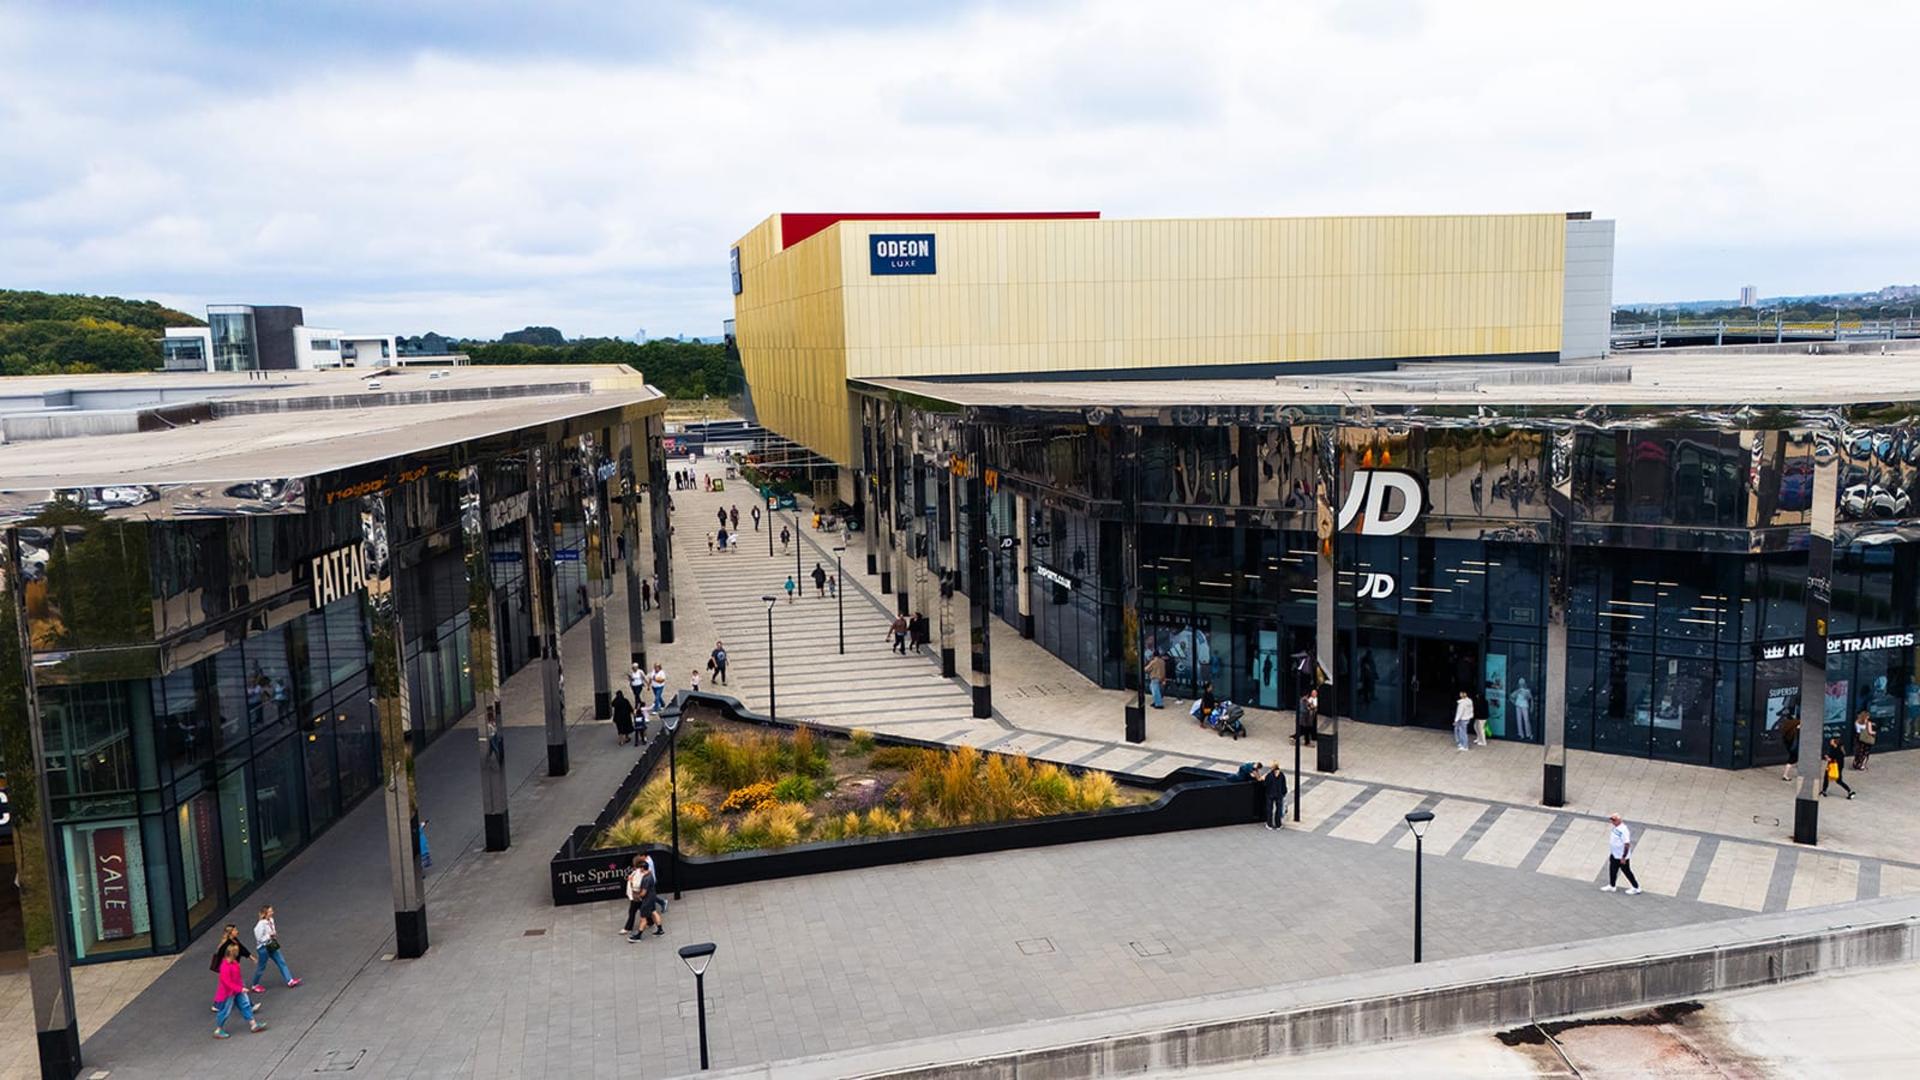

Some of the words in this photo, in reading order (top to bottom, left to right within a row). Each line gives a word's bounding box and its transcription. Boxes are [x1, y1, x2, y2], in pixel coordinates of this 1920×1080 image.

[877, 240, 929, 257] ODEON
[891, 260, 917, 268] LUXE
[1338, 471, 1422, 535] JD
[1001, 538, 1012, 548] JD
[1357, 573, 1395, 598] JD
[1827, 640, 1840, 650] OF
[1843, 633, 1914, 652] TRAINERS
[100, 854, 127, 909] SALE
[558, 871, 585, 884] The
